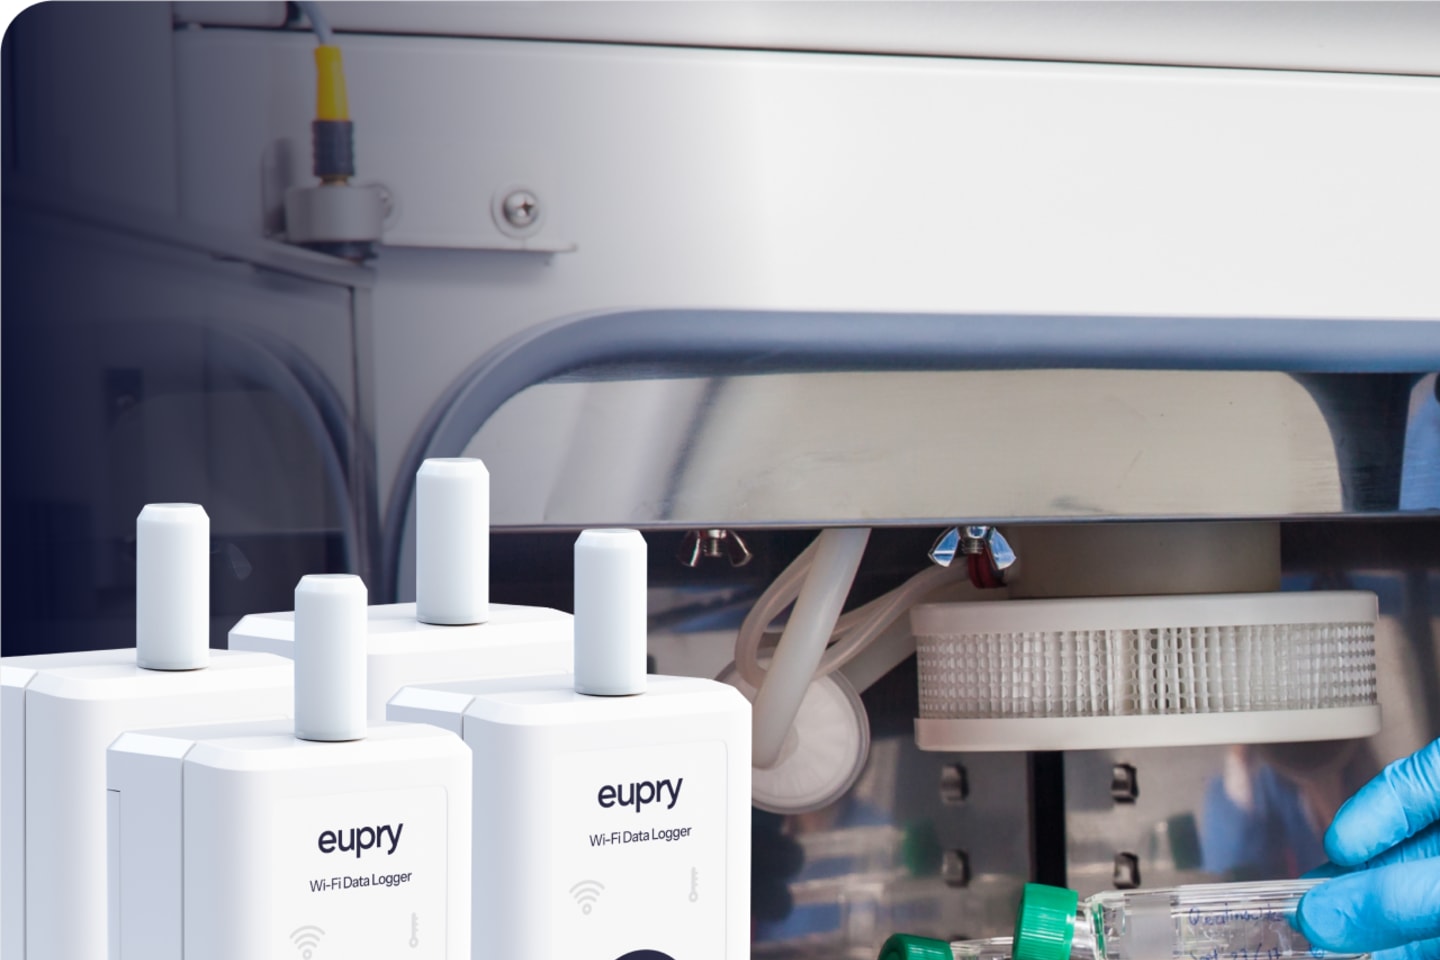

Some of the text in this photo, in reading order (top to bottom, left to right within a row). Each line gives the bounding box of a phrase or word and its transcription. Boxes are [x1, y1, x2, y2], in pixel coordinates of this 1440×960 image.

[597, 777, 684, 813] eupry
[318, 822, 404, 859] eupry
[589, 827, 692, 847] Wi-Fi Data Logger
[309, 872, 413, 892] Wi-Fi Data Logger
